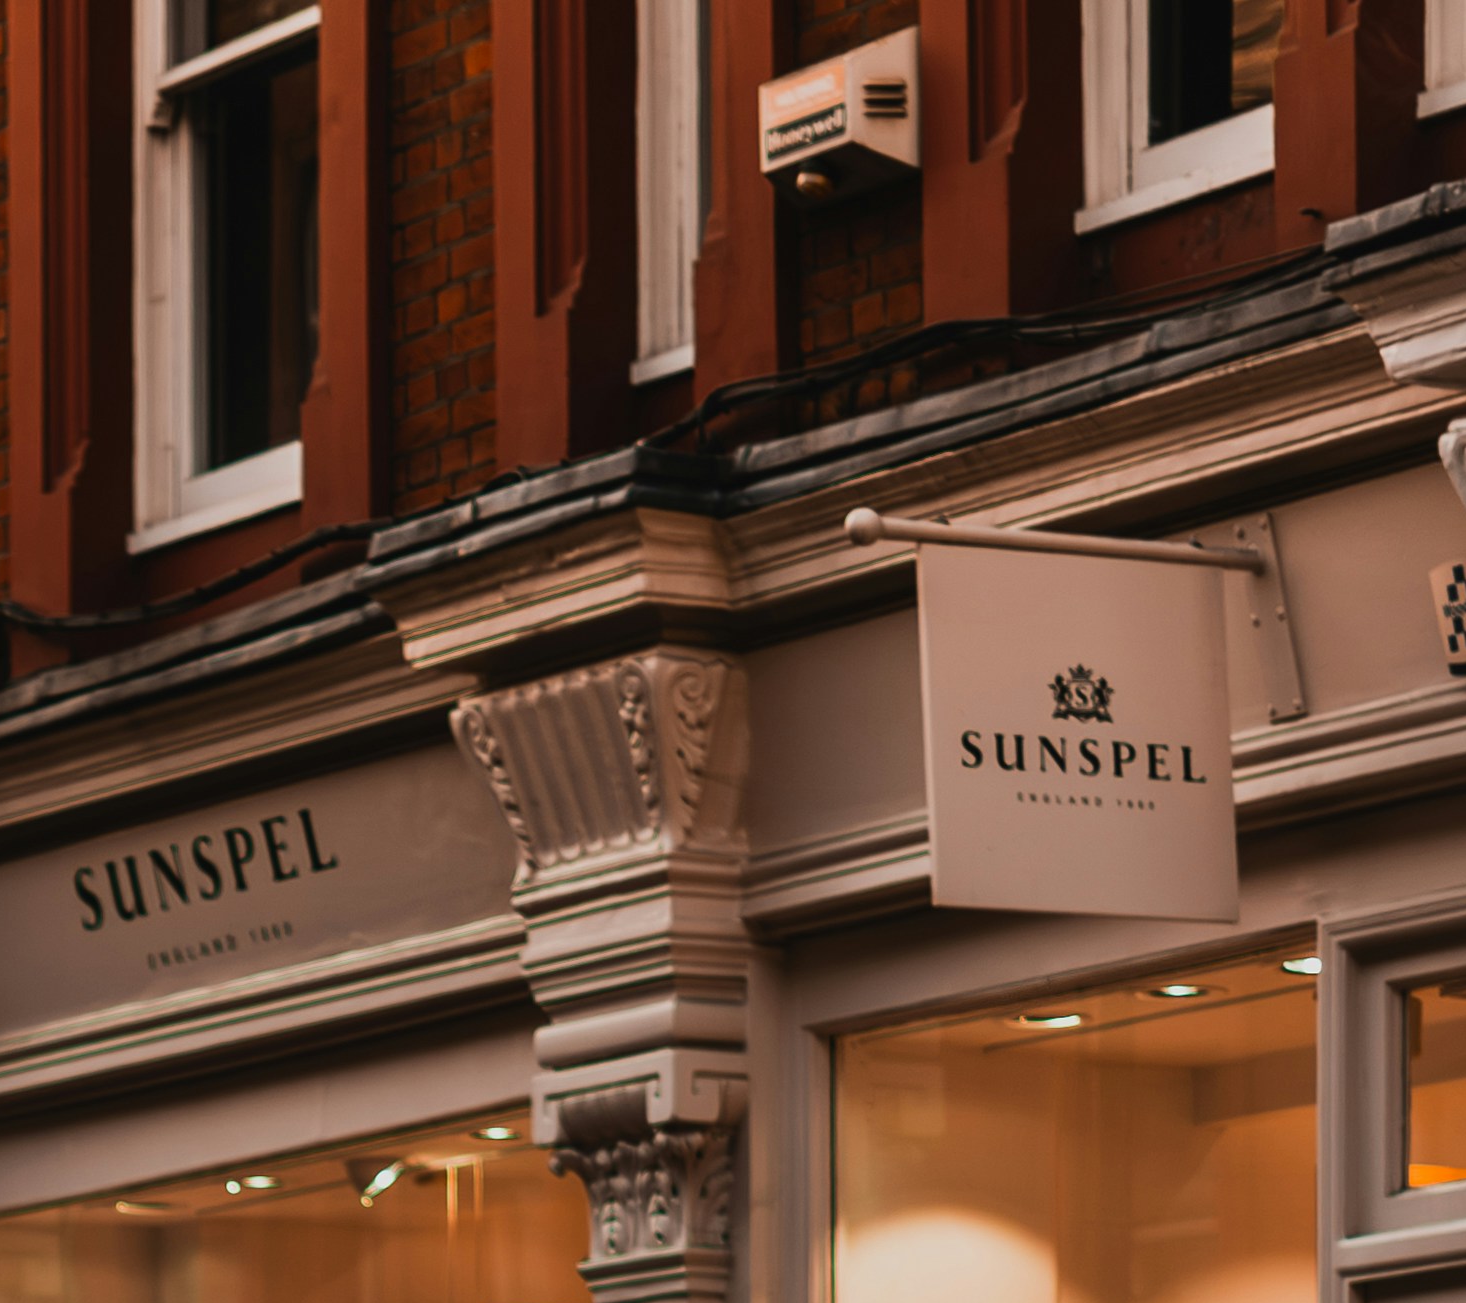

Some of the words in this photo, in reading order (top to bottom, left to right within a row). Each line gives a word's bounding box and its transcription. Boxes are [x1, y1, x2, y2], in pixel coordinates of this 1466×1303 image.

[768, 109, 843, 152] Honeywell
[961, 730, 1207, 784] SUNSPEL
[1016, 791, 1103, 808] ENGLAND
[74, 808, 339, 931] SUNSPEL
